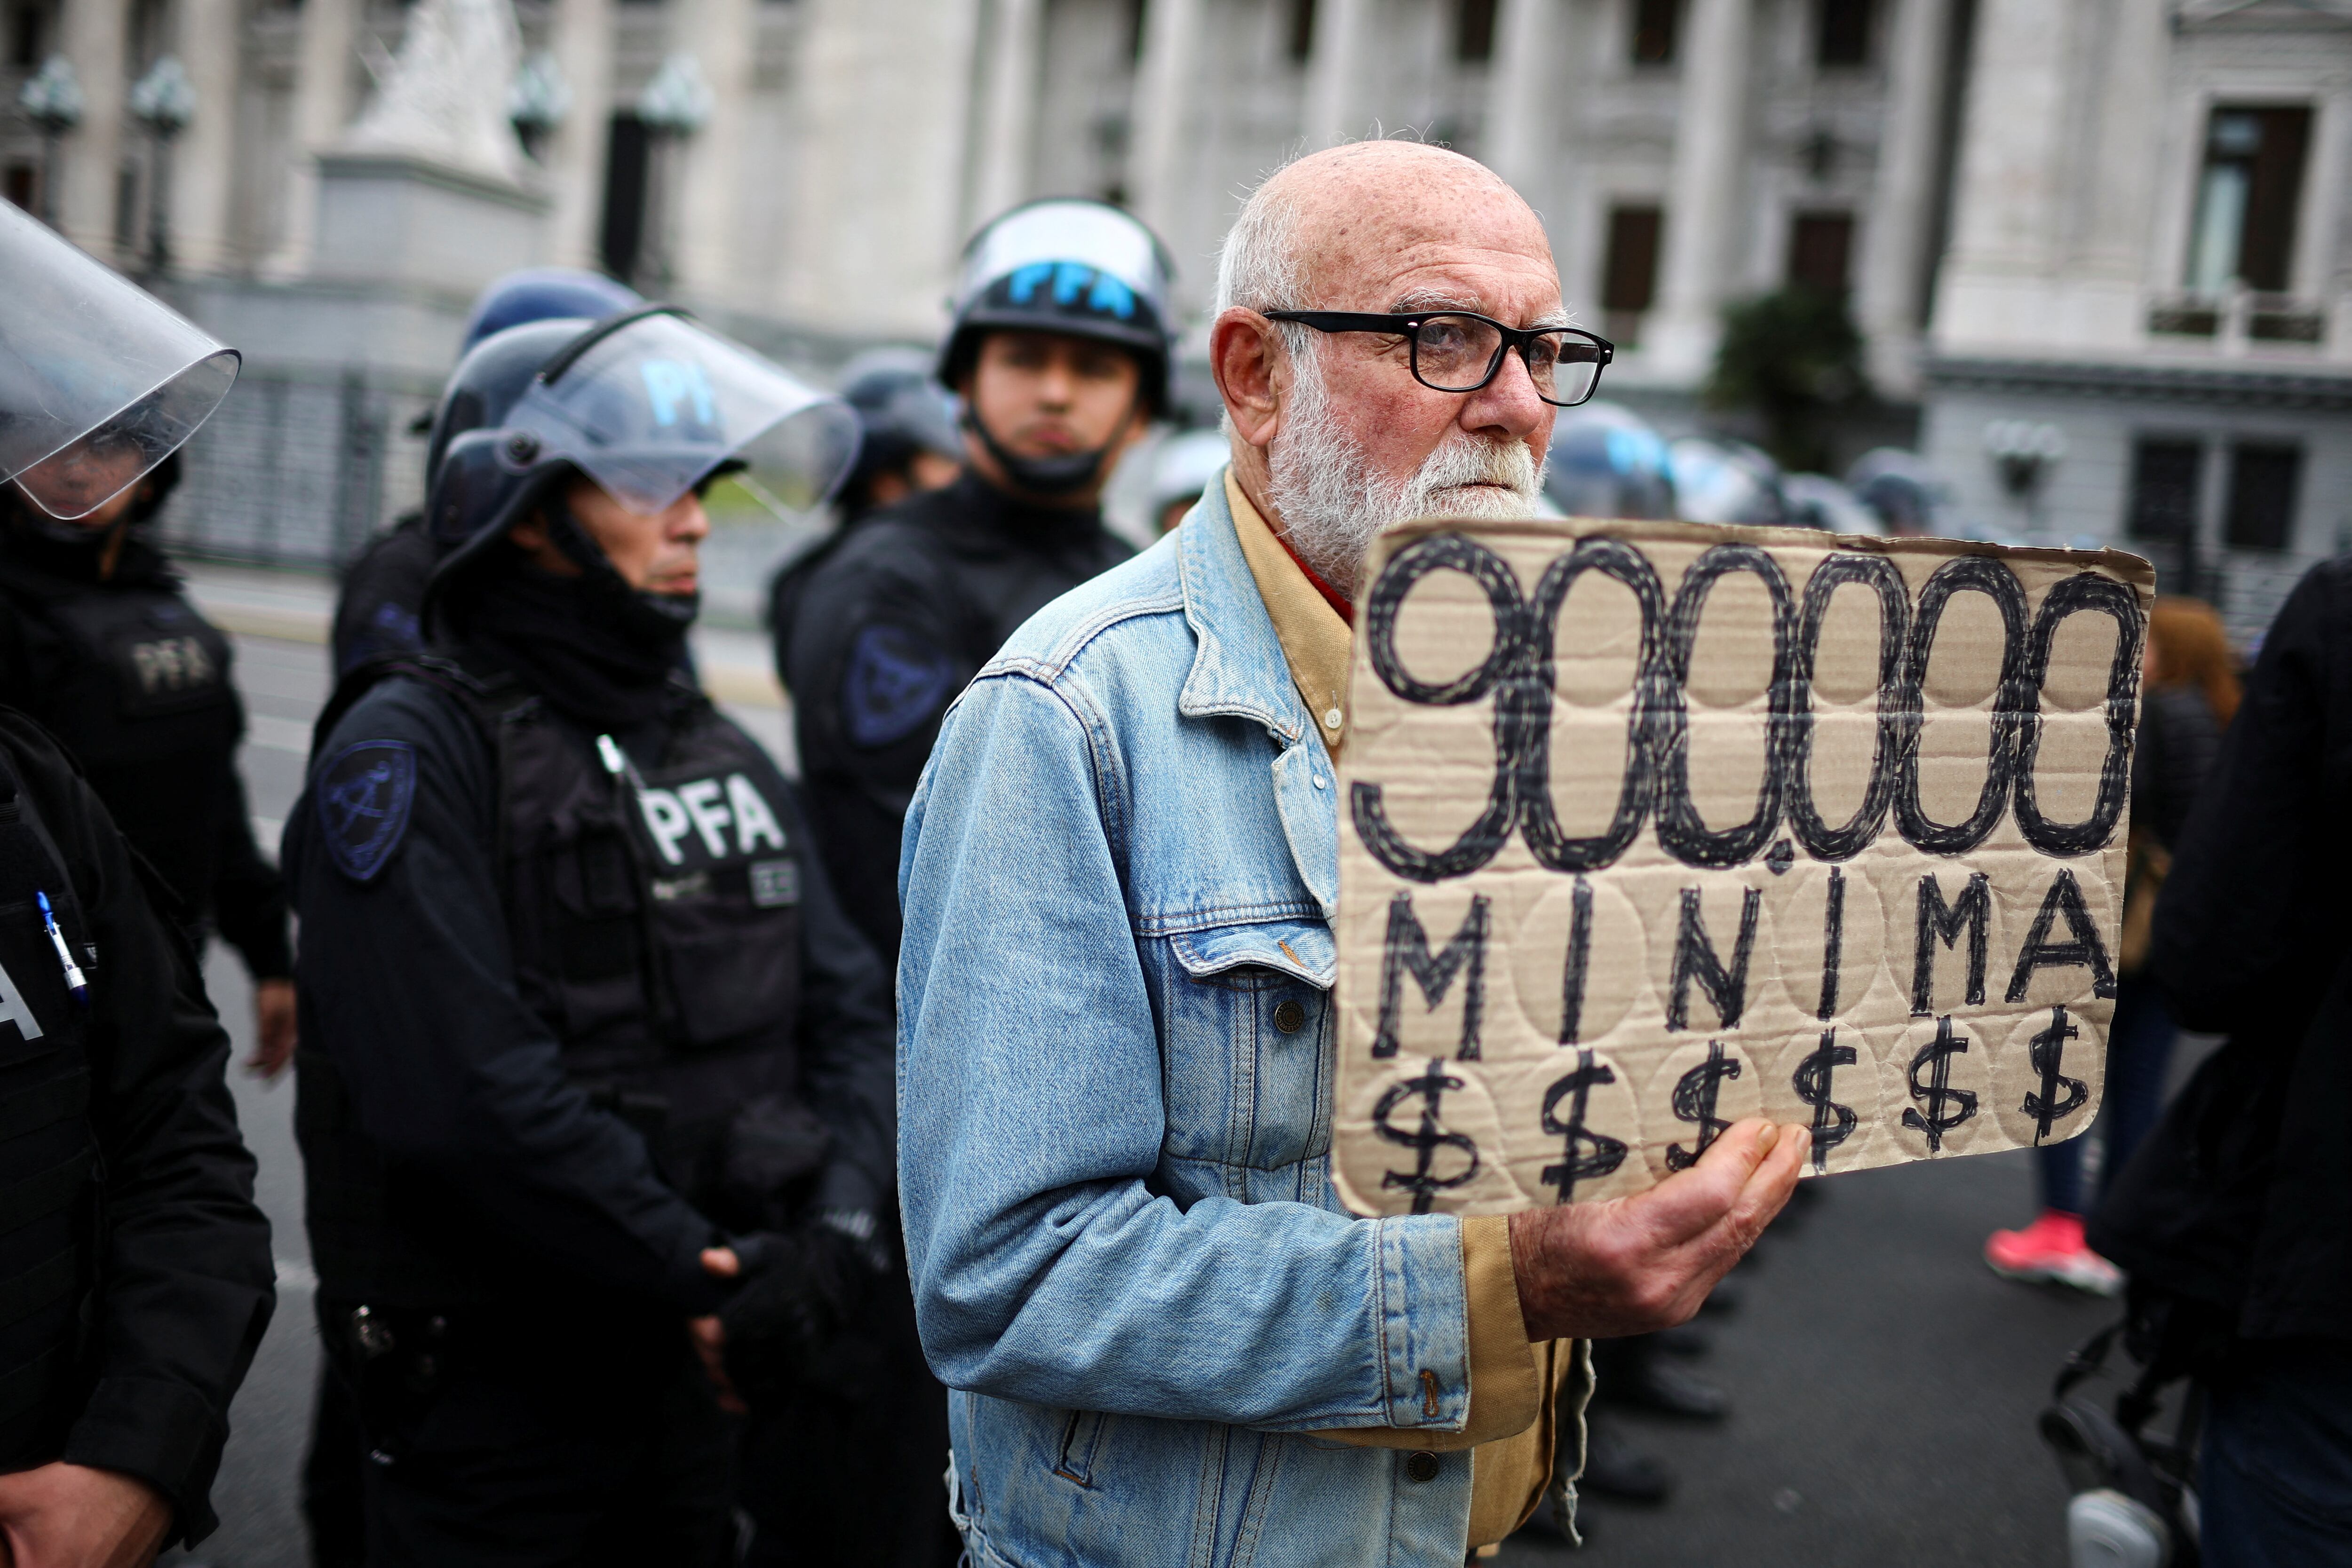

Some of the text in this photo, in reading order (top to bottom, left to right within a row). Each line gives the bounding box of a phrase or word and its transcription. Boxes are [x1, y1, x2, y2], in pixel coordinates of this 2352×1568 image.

[1351, 532, 2144, 883] 900.000
[638, 774, 786, 865] PFA
[1372, 865, 2116, 1061] MINIMA
